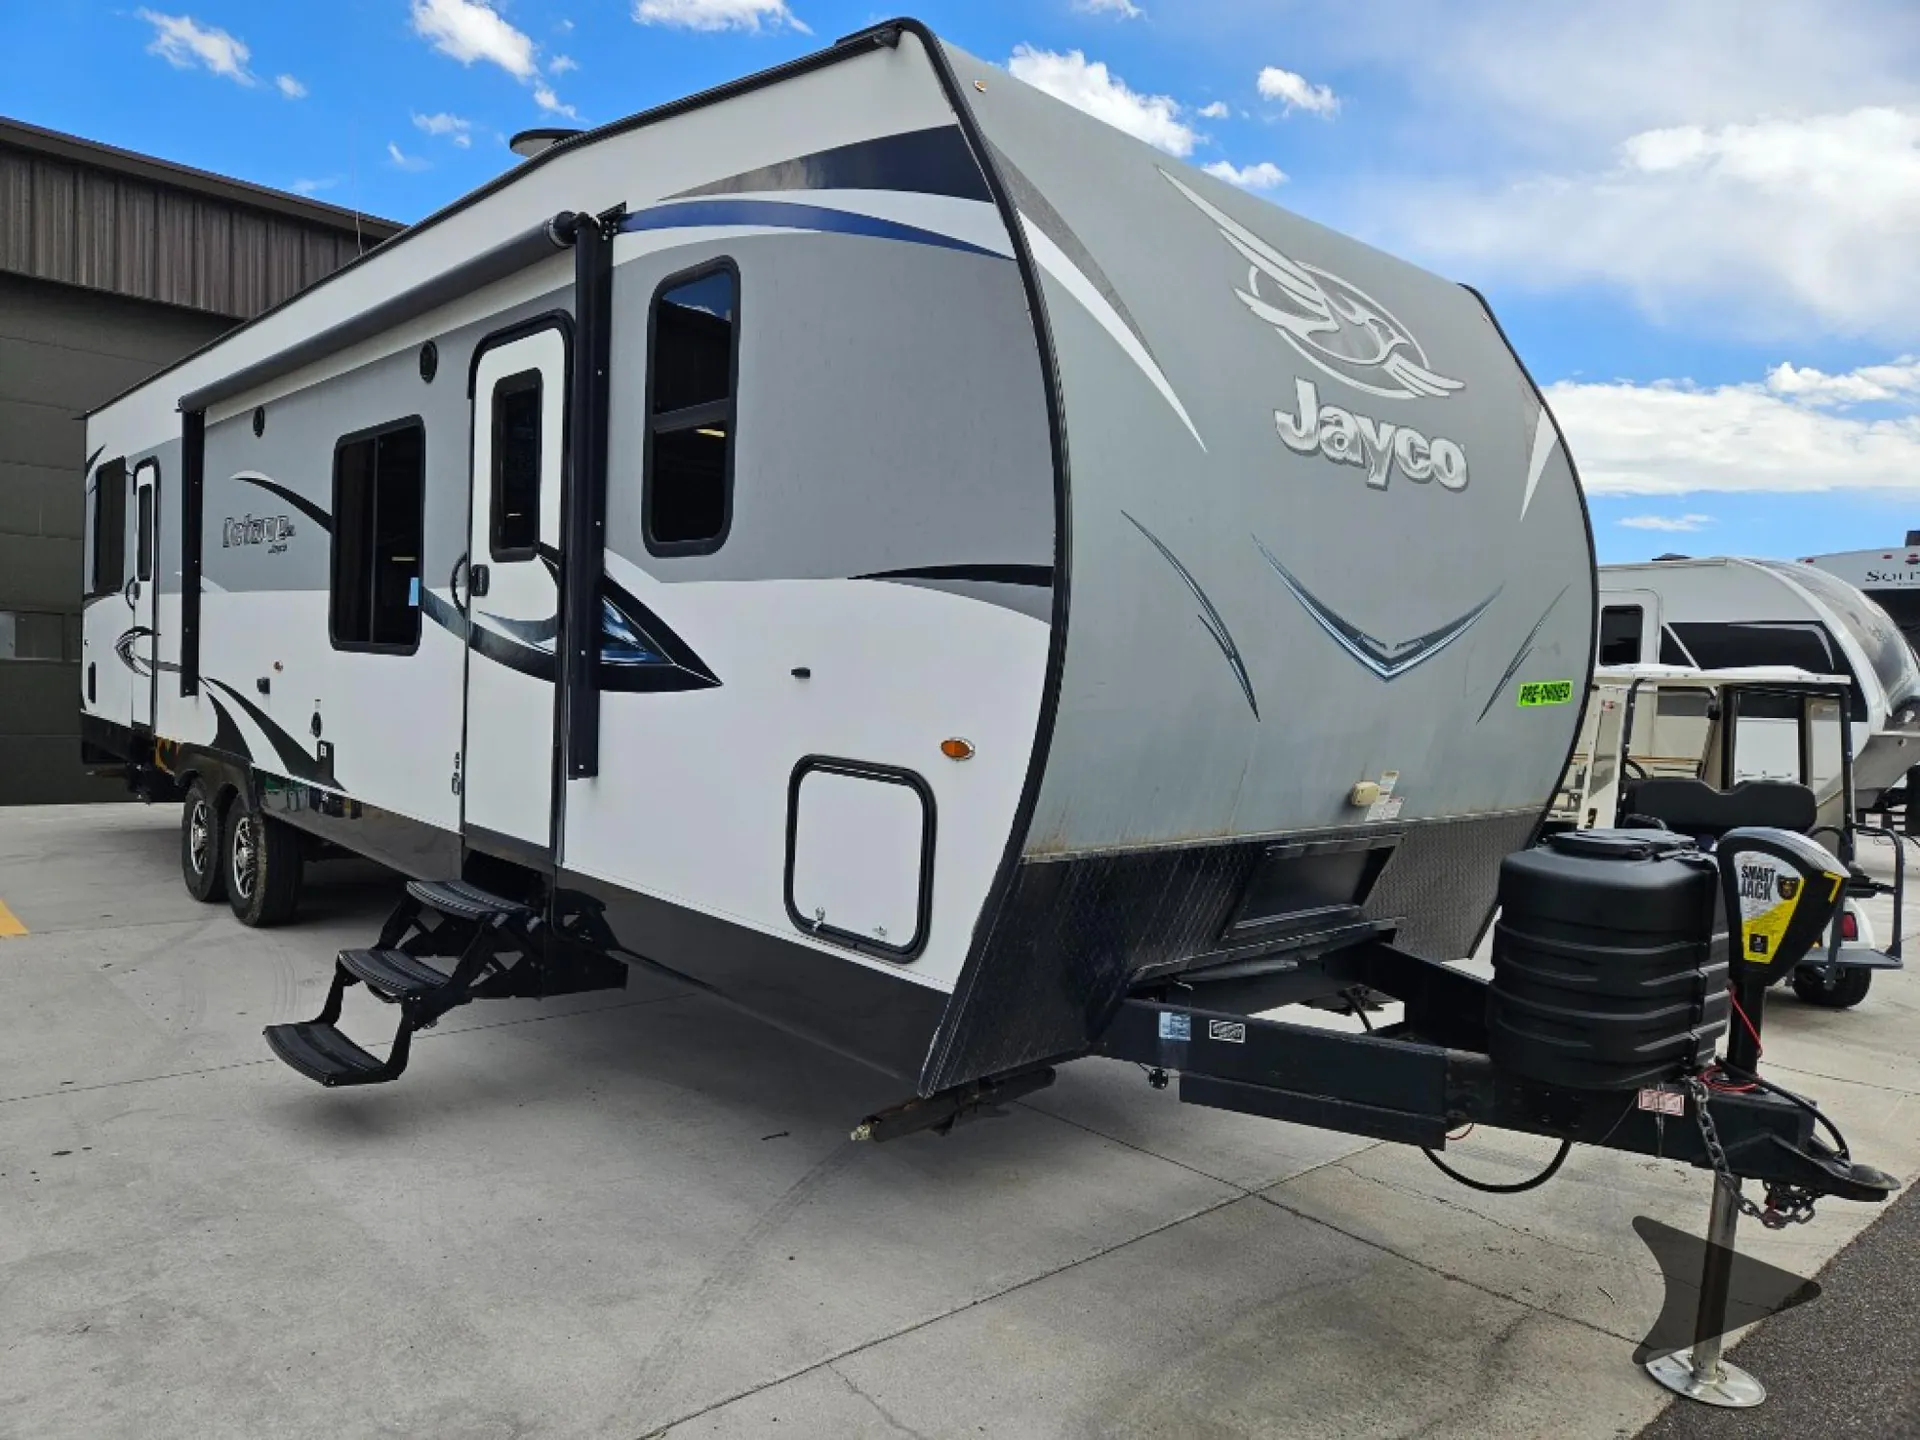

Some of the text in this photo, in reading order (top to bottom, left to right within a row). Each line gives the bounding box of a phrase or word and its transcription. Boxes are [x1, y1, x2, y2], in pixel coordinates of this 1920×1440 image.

[1274, 376, 1469, 493] Jayco
[1741, 864, 1776, 884] SMART
[1740, 878, 1774, 901] JACK
